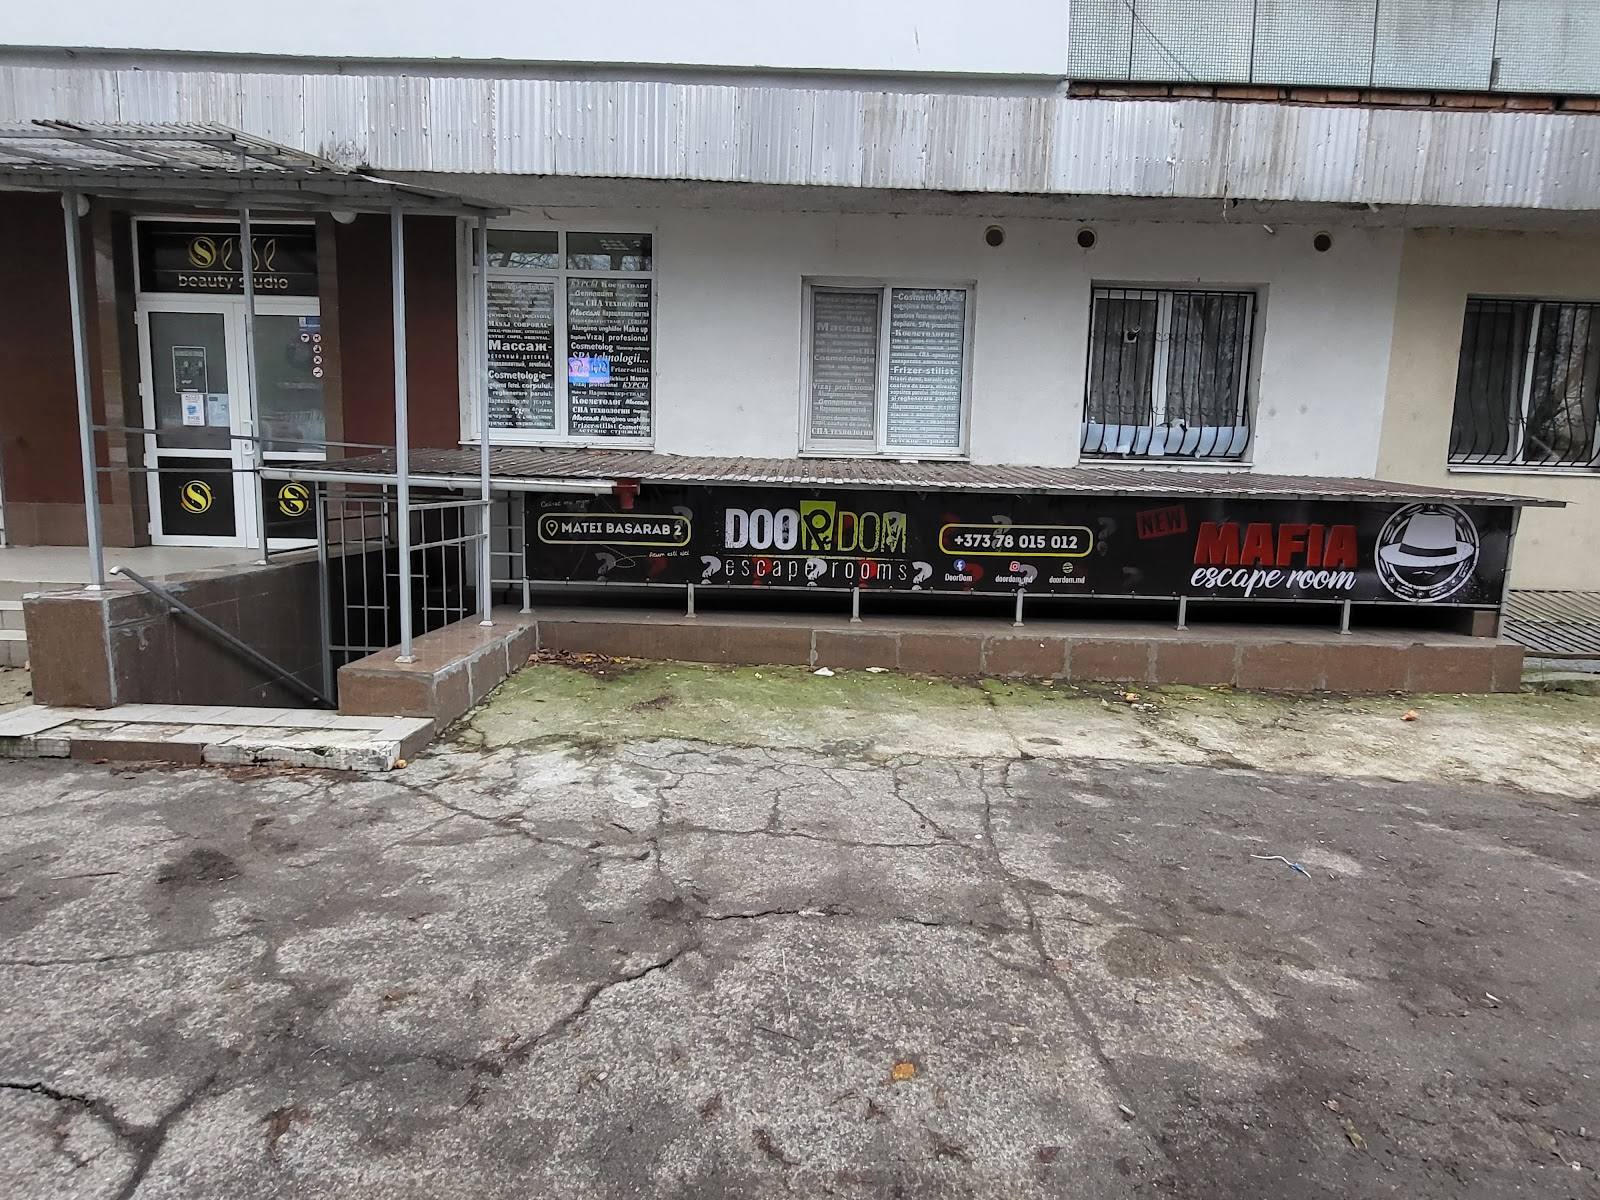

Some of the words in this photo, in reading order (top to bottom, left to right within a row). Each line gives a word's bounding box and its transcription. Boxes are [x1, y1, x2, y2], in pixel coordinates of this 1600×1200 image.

[178, 273, 233, 290] beauty
[238, 273, 289, 289] sudio
[586, 333, 605, 343] Vizaj
[608, 334, 649, 343] profesional
[570, 341, 614, 353] Cosmetolog
[572, 395, 622, 405] Косметолог
[572, 406, 588, 414] СПА
[561, 522, 603, 534] MATEI
[606, 523, 671, 535] BASARAB
[674, 524, 682, 536] 2
[1142, 510, 1182, 534] NEW
[954, 534, 991, 548] +373
[995, 534, 1014, 548] 78
[1018, 535, 1046, 549] 015
[1051, 535, 1078, 549] 012
[1193, 521, 1358, 568] MAFIA
[725, 558, 814, 582] escape
[831, 559, 908, 582] rooms
[944, 573, 973, 582] DoorDom
[1048, 575, 1086, 584] doordom.md
[1190, 566, 1284, 598] escape
[1285, 568, 1358, 591] room
